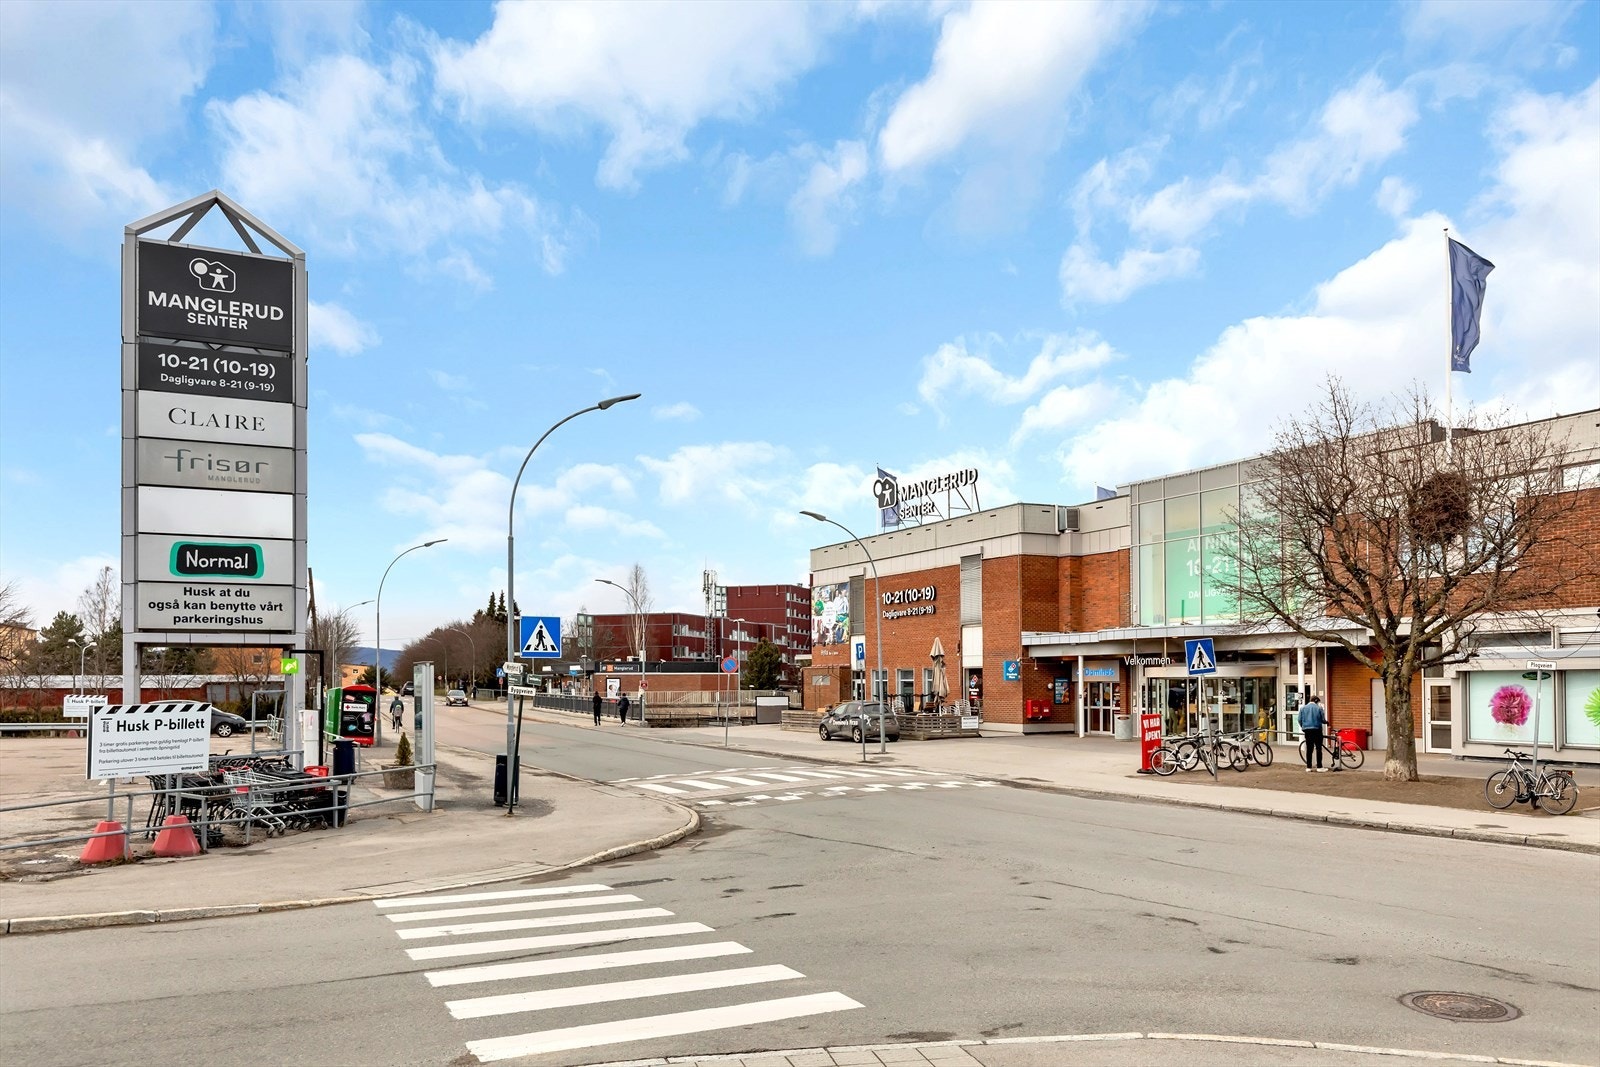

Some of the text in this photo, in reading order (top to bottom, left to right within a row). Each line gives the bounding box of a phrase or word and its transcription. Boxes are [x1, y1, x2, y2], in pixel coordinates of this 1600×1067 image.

[148, 290, 284, 320] MANGLERUD
[187, 312, 248, 330] SENTER
[158, 354, 276, 378] 10-21 (10-19)
[160, 374, 275, 392] Dagligvare 8-21 (9-19)
[168, 407, 266, 432] CLAIRE
[164, 448, 269, 474] frisør
[208, 474, 261, 484] MANGLERUD
[899, 468, 978, 502] MANGLERUD
[900, 502, 935, 520] SENTER
[186, 550, 248, 569] Normal
[184, 587, 250, 598] Husk at du
[882, 586, 934, 604] 10-21 (10-19)
[148, 599, 283, 612] også kan benytte vårt
[883, 609, 906, 620] Dagligvare
[919, 605, 934, 615] (9-19)
[173, 615, 263, 625] parkeringshus
[1124, 655, 1170, 665] Velkommen
[1084, 668, 1114, 676] Domino's
[116, 720, 149, 732] Husk
[155, 718, 205, 730] P-billett
[1143, 718, 1160, 729] VI HAR
[1145, 730, 1160, 741] ÅPENT
